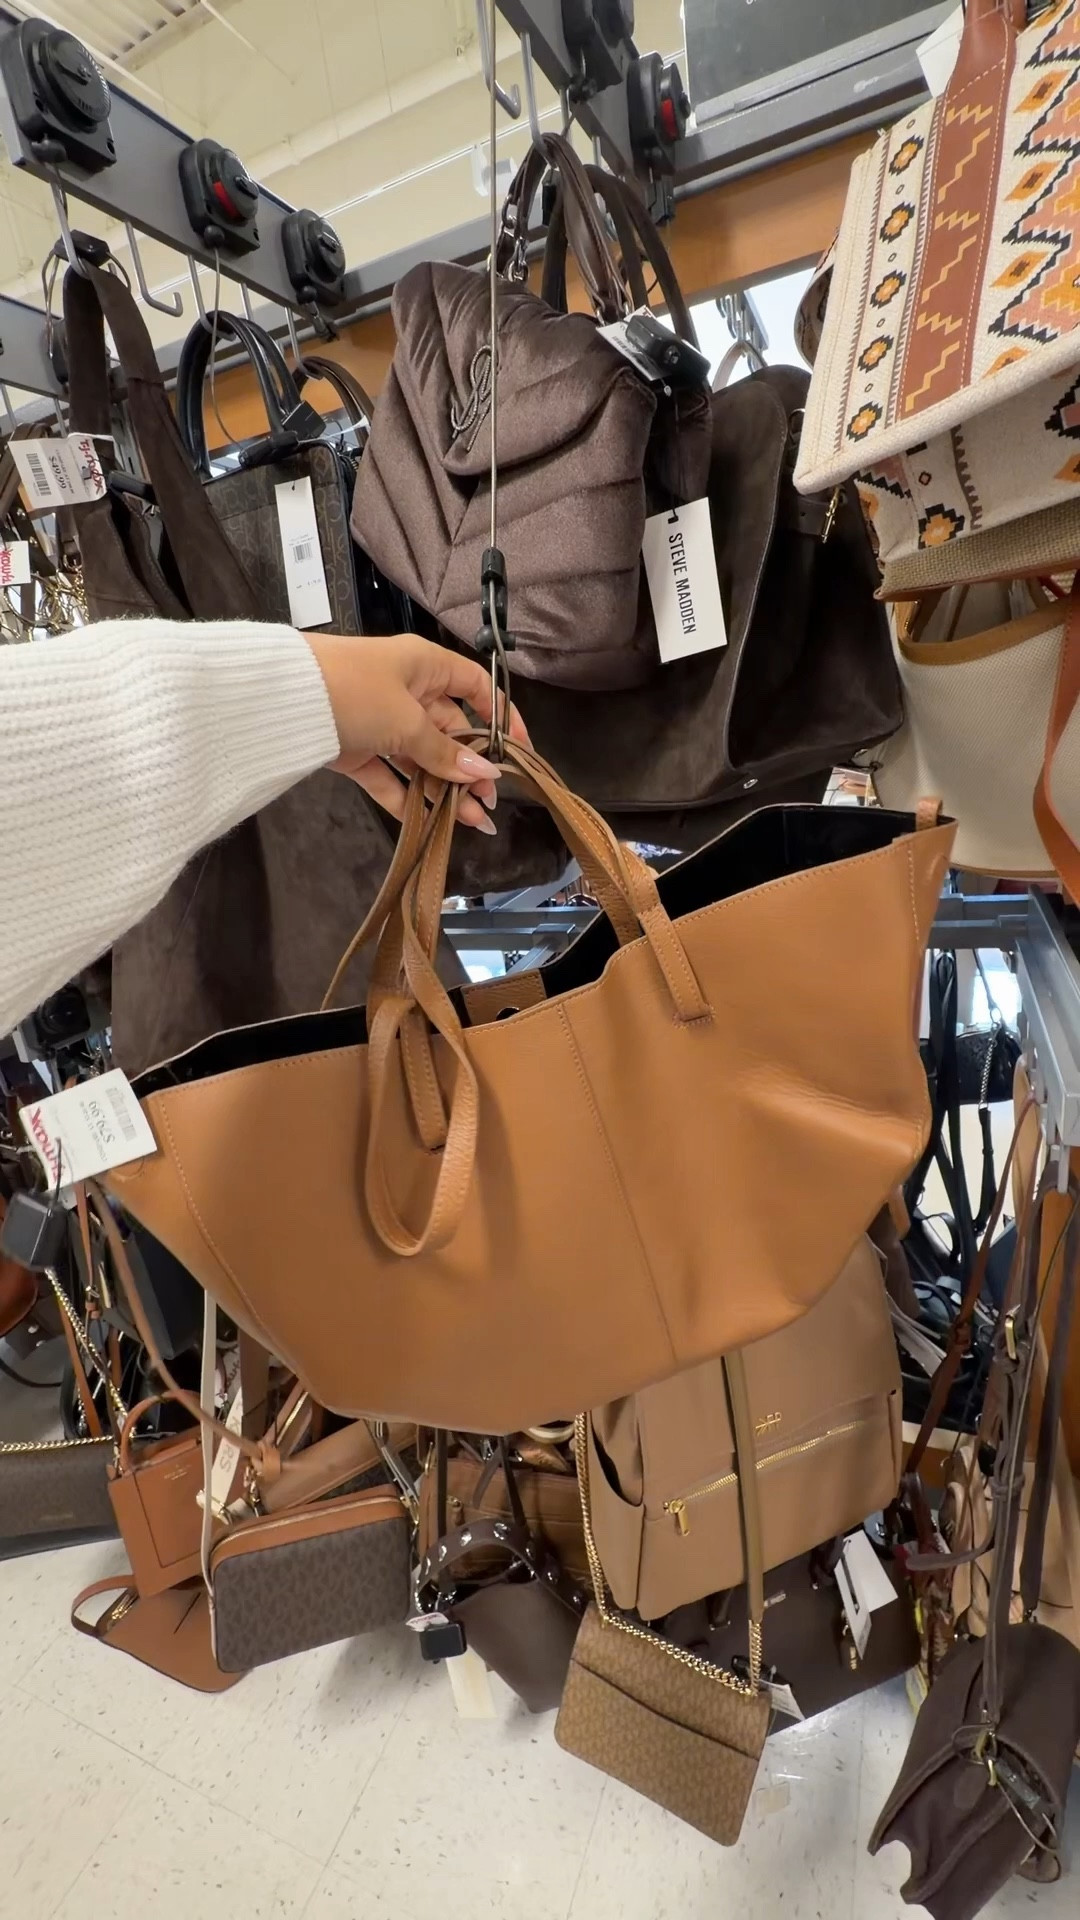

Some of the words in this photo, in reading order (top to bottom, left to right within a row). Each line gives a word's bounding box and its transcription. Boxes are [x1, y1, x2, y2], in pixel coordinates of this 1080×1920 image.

[48, 455, 67, 490] $49.99
[668, 532, 688, 576] STEVE
[675, 578, 697, 635] MADDEN
